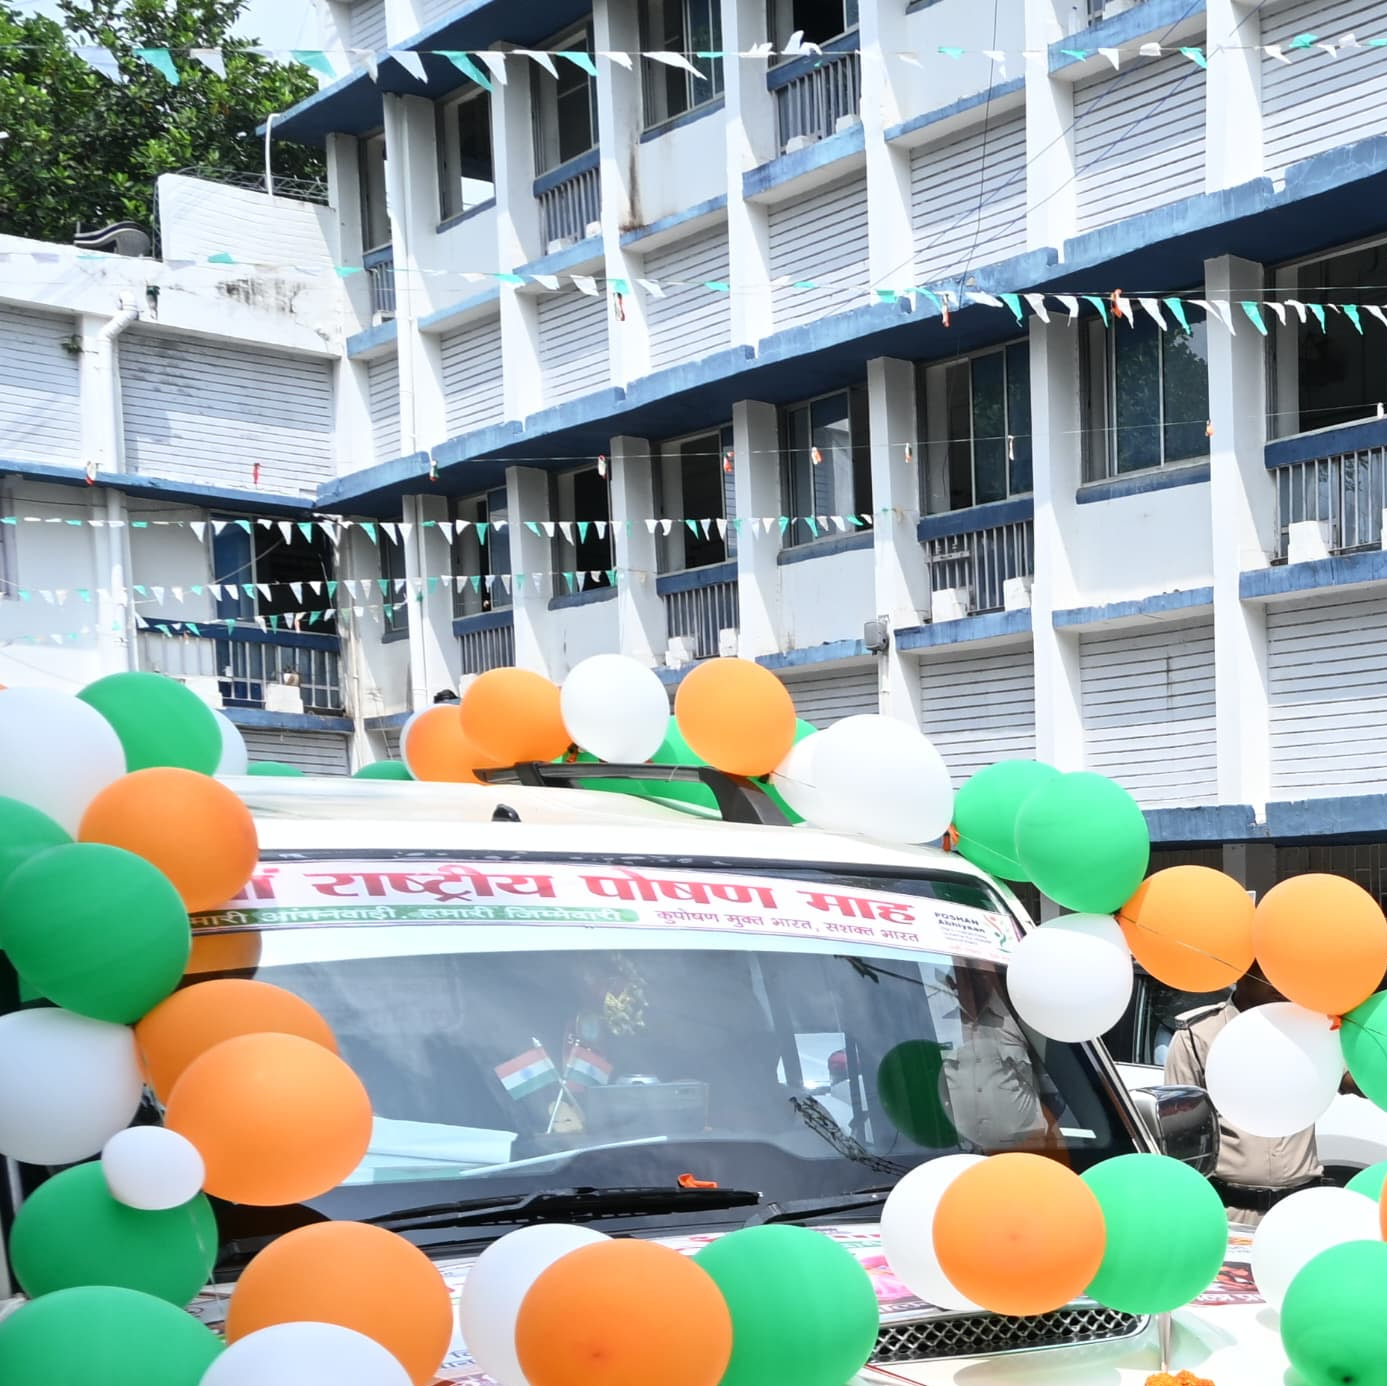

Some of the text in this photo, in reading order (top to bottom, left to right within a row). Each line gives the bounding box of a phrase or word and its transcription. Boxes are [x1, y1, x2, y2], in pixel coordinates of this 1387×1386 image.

[303, 863, 558, 903] राष्ट्रीय
[577, 864, 777, 909] पोषण
[796, 889, 917, 925] माह
[191, 911, 248, 926] मारी
[655, 908, 719, 925] कुपोषण
[727, 914, 764, 929] मुक्त
[826, 922, 875, 937] सशक्त
[880, 929, 920, 944] भारत
